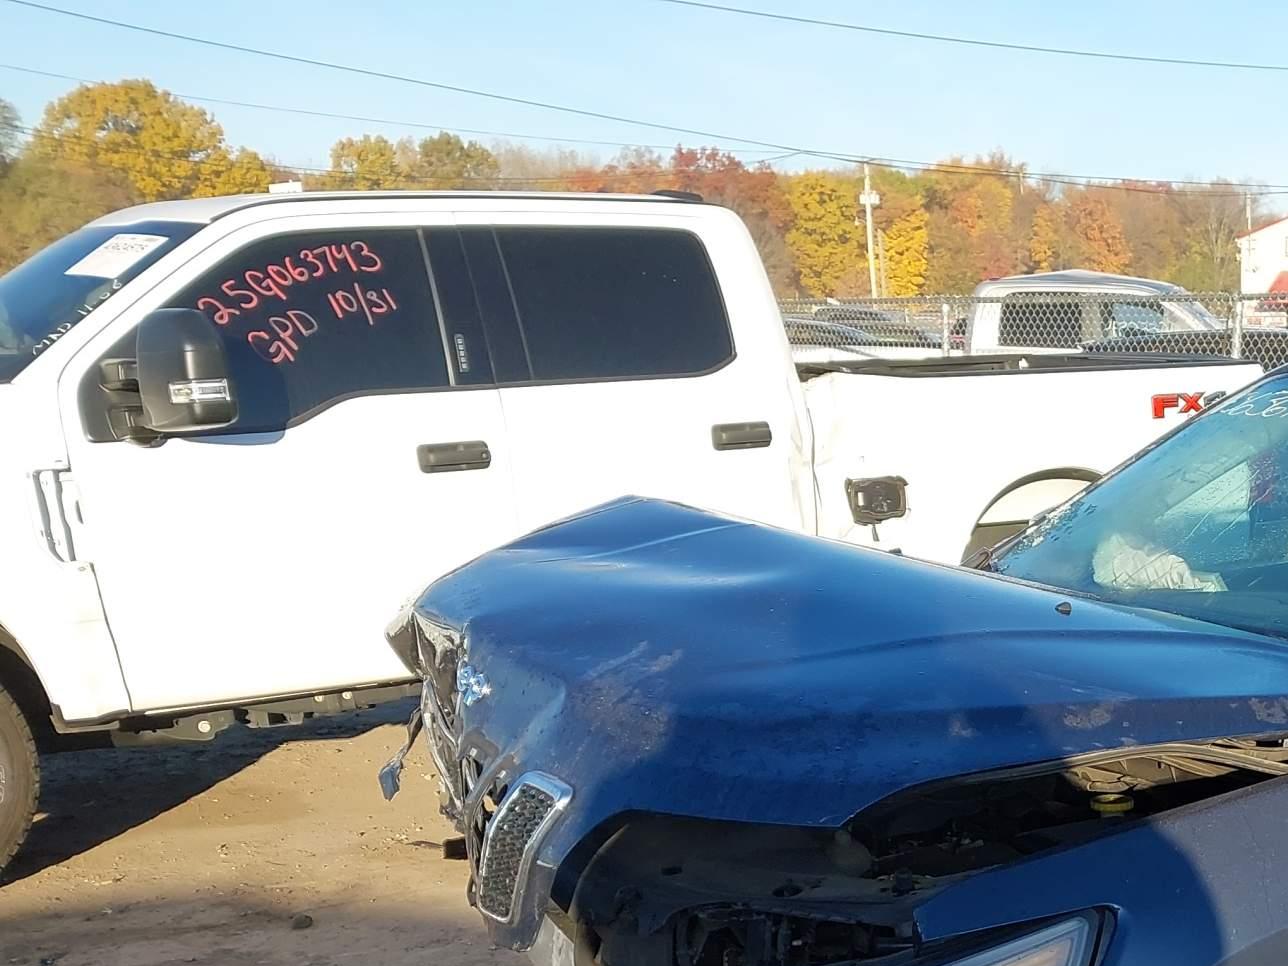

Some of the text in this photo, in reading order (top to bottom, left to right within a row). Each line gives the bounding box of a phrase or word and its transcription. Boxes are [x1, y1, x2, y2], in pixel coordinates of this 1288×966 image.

[198, 241, 382, 324] 25G063743
[248, 282, 398, 363] GPD 10/31
